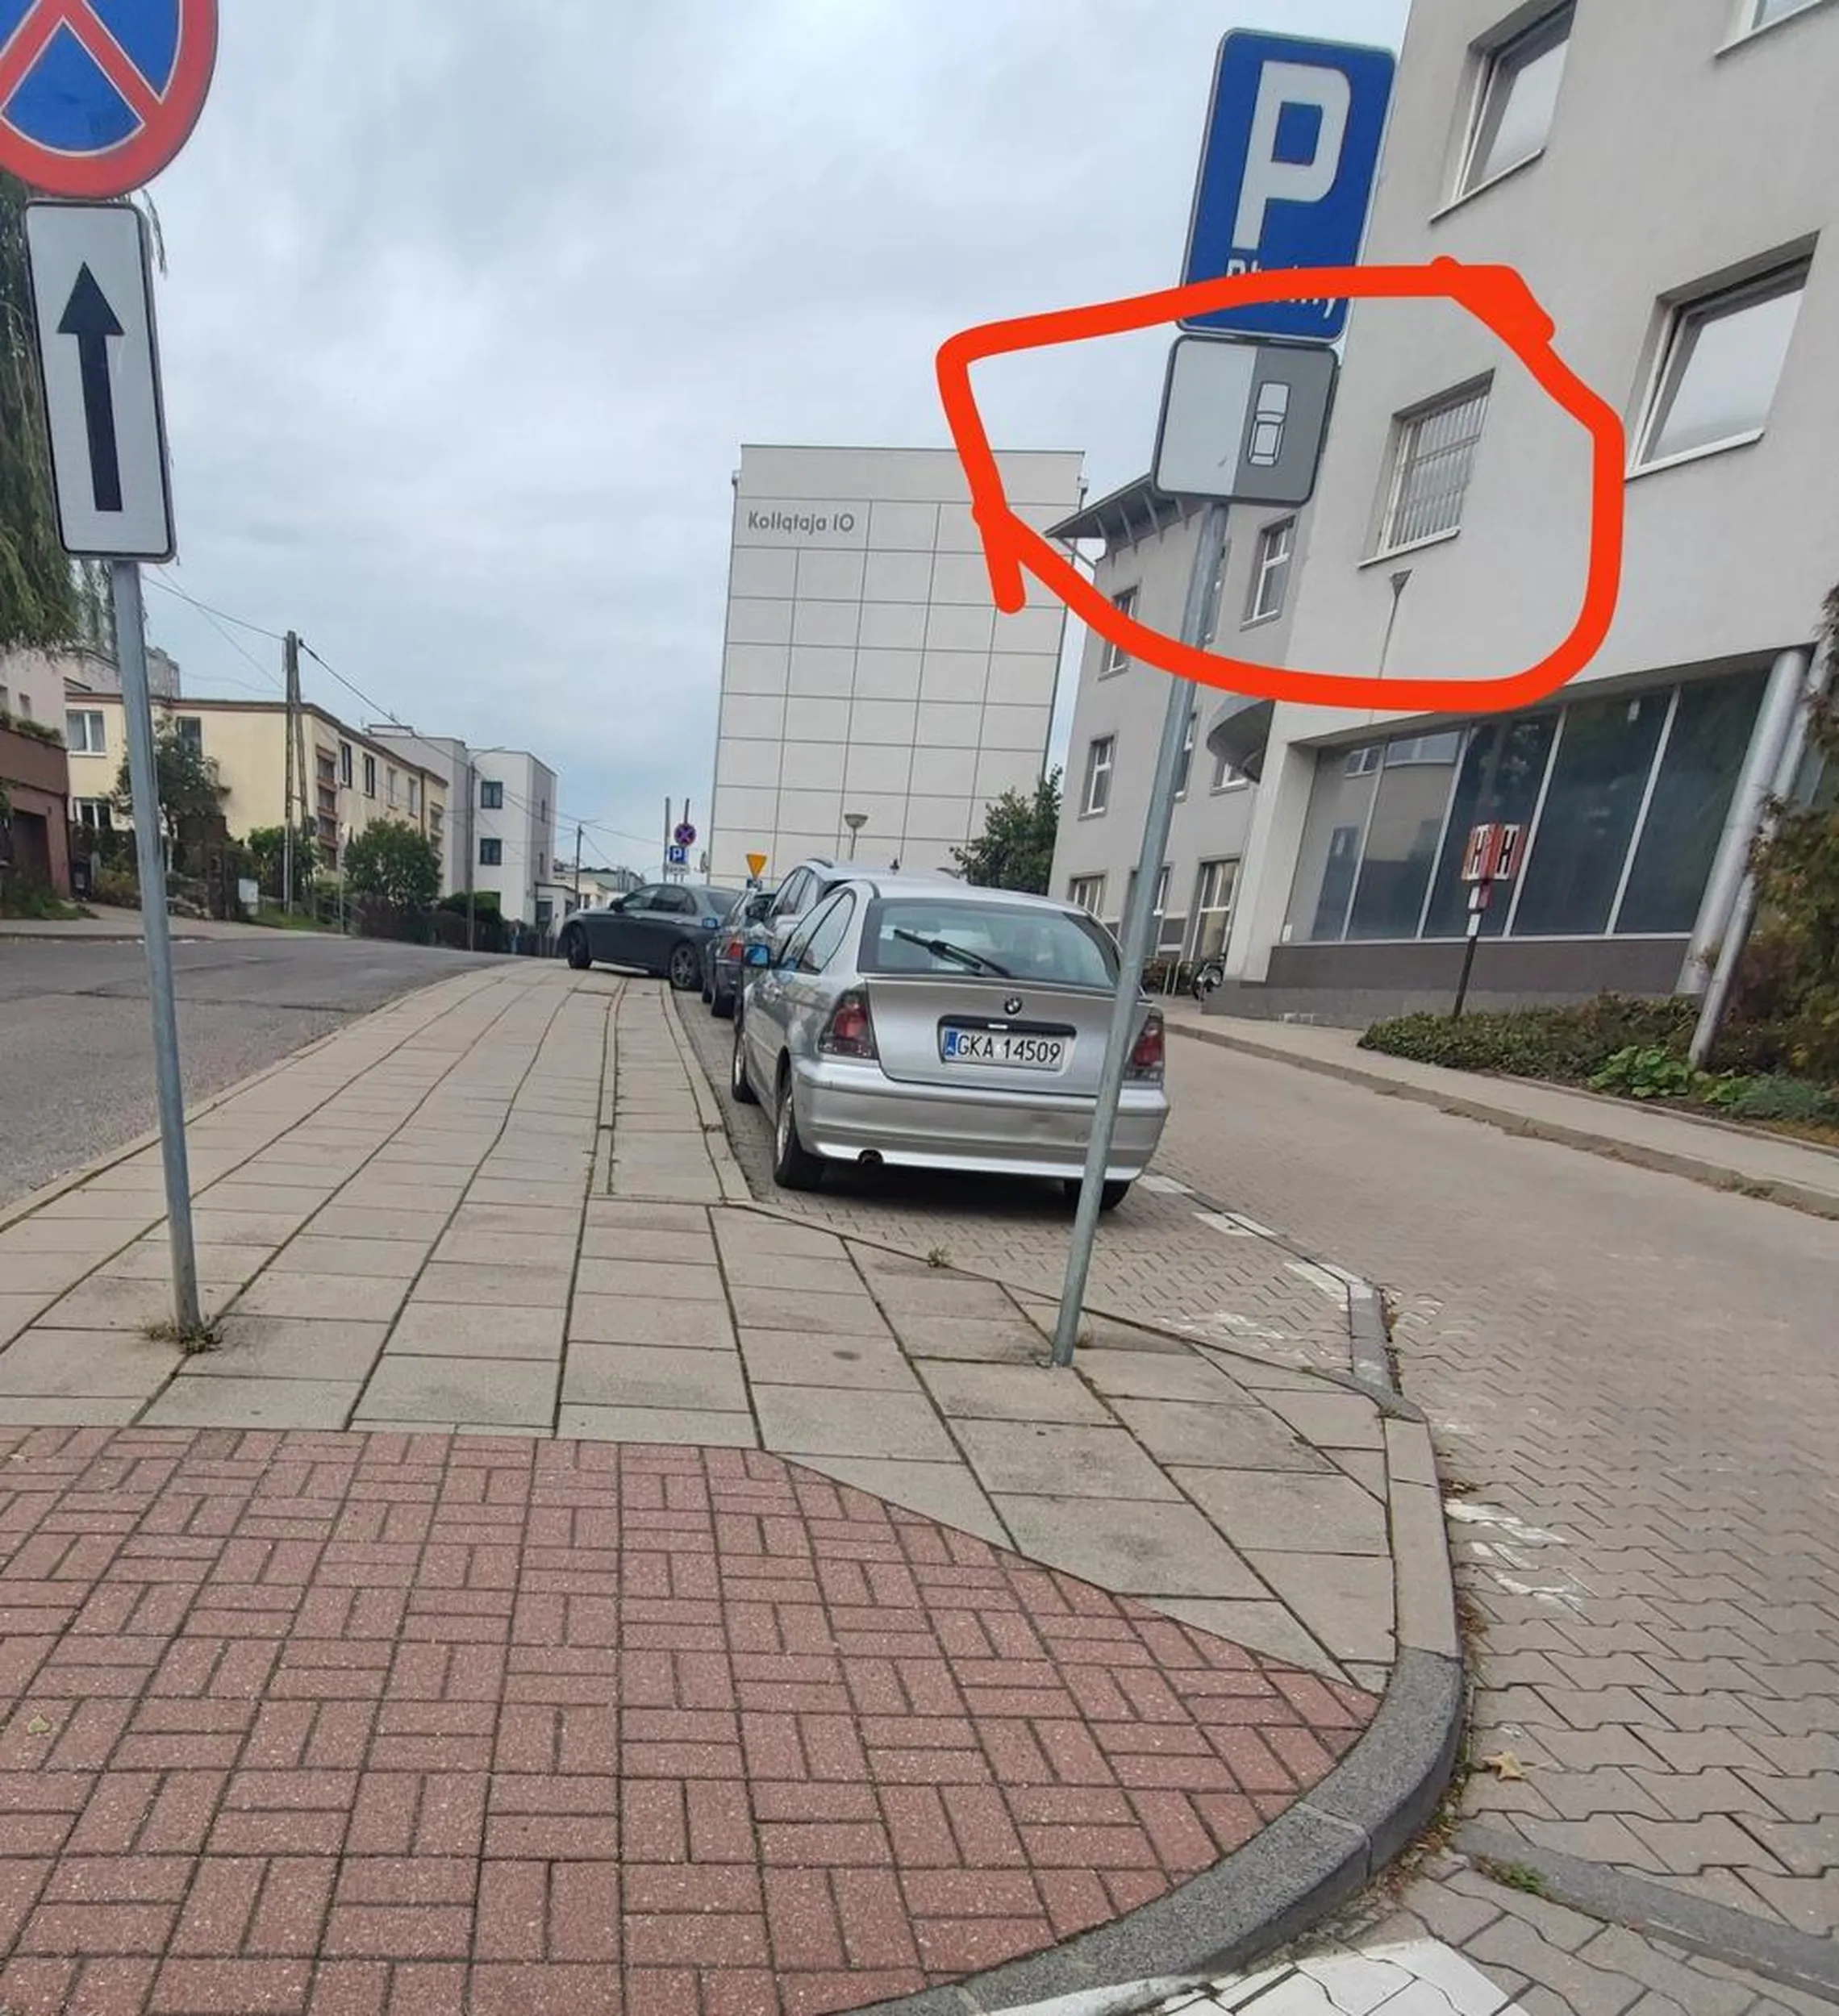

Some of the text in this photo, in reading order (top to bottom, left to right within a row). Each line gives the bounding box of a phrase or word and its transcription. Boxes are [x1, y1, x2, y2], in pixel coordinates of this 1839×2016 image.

[1231, 60, 1352, 251] P
[832, 512, 855, 532] 10
[957, 1035, 1061, 1064] GKA 14509
